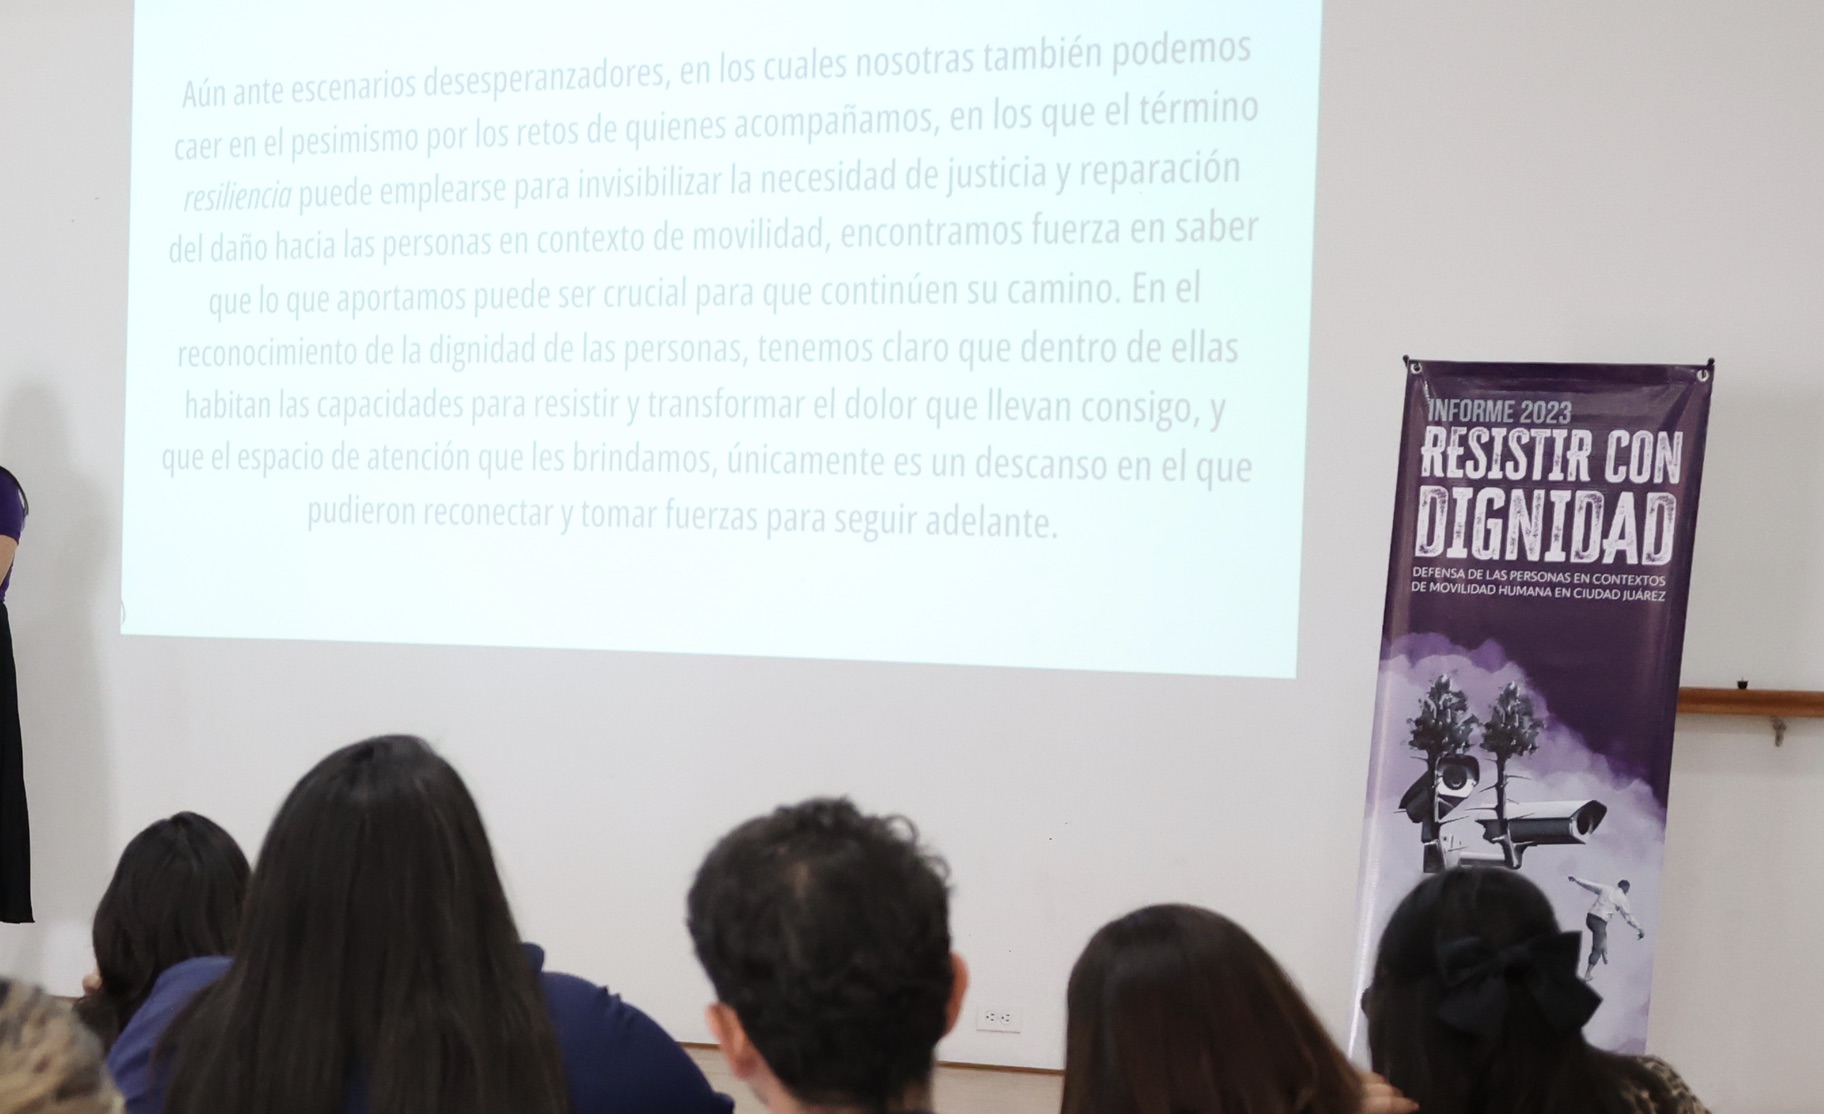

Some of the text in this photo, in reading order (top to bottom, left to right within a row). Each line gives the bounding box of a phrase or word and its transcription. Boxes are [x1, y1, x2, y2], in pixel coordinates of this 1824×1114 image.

[182, 30, 1251, 108] Aún ante escenarios desesperanzadores, en los cuales nosotras también podemos
[175, 89, 1258, 164] caer en el pesimismo por los retos de quienes acompañamos, en los que el término
[183, 148, 1240, 216] resiliencia puede emplearse para invisibilizar la necesidad de justicia y reparación
[169, 208, 1259, 266] del daño hacia las personas en contexto de movilidad, encontramos fuerza en saber
[209, 268, 1200, 323] que lo que aportamos puede ser crucial para que continúen su camino. En el
[178, 328, 1238, 373] reconocimiento de la dignidad de las personas, tenemos claro que dentro de ellas
[185, 386, 1226, 433] habitan las capacidades para resistir y transformar el dolor que llevan consigo, y
[1428, 399, 1572, 424] INFORME 2023
[162, 440, 1252, 492] que el espacio de atención que les brindamos, únicamente es un descanso en el que
[1421, 426, 1683, 485] RESISTIR CON
[308, 493, 1057, 543] pudieron reconectar y tomar fuerzas para seguir adelante.
[1414, 485, 1677, 566] DIGNIDAD
[1411, 581, 1666, 601] DE MOVILIDAD HUMANA EN CIUDAD JUÁREZ
[1413, 567, 1666, 586] DEFENSA DE LAS PERSONAS EN CONTEXTOS
